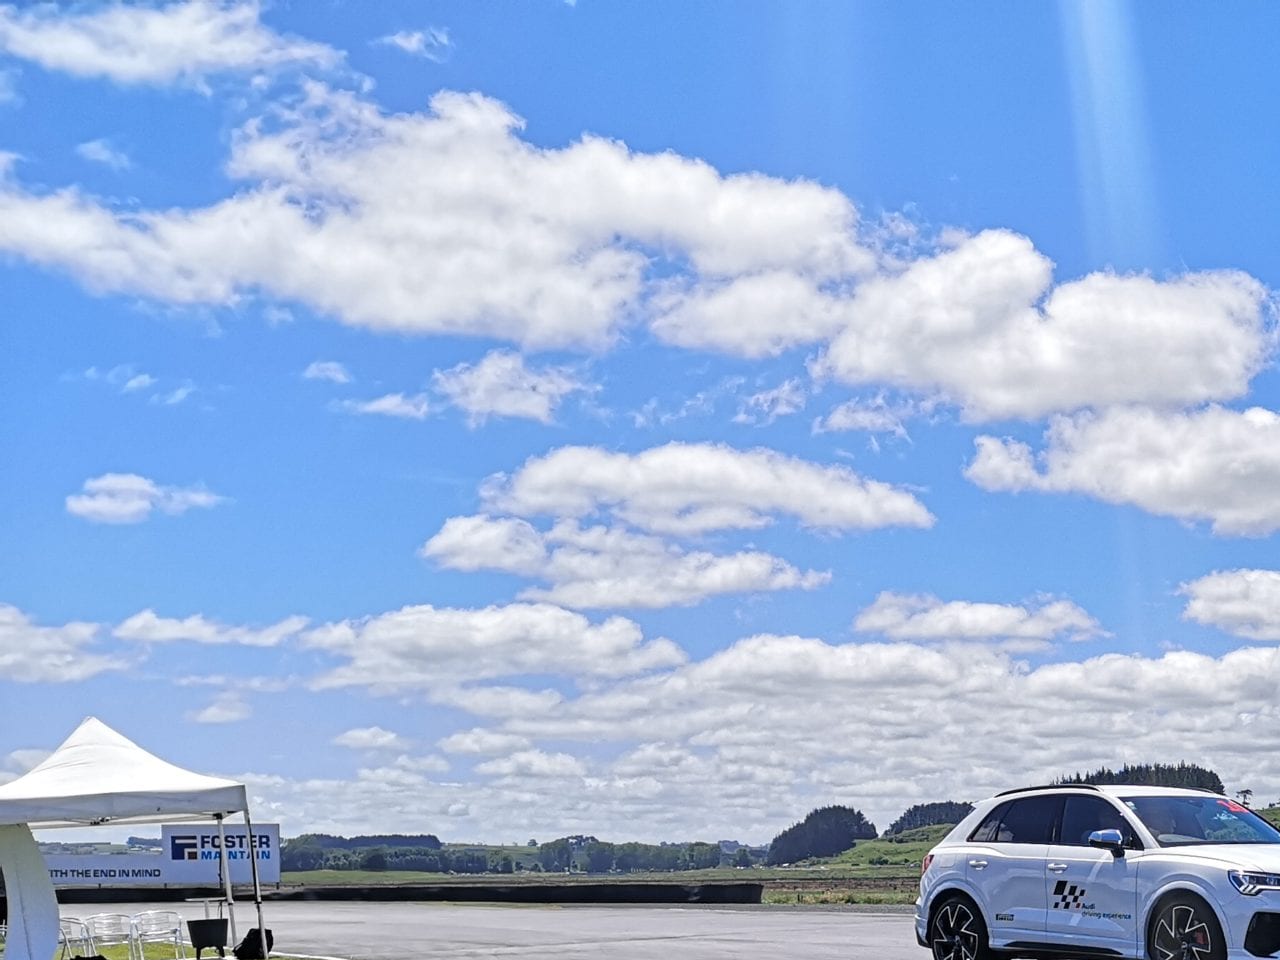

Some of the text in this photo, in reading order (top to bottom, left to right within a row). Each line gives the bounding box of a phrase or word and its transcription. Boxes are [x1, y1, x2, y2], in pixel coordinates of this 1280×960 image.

[200, 834, 271, 849] FOSTER
[70, 869, 91, 878] THE
[93, 869, 117, 878] END
[118, 869, 130, 878] IN
[131, 869, 161, 878] MIND
[1102, 912, 1132, 920] experience
